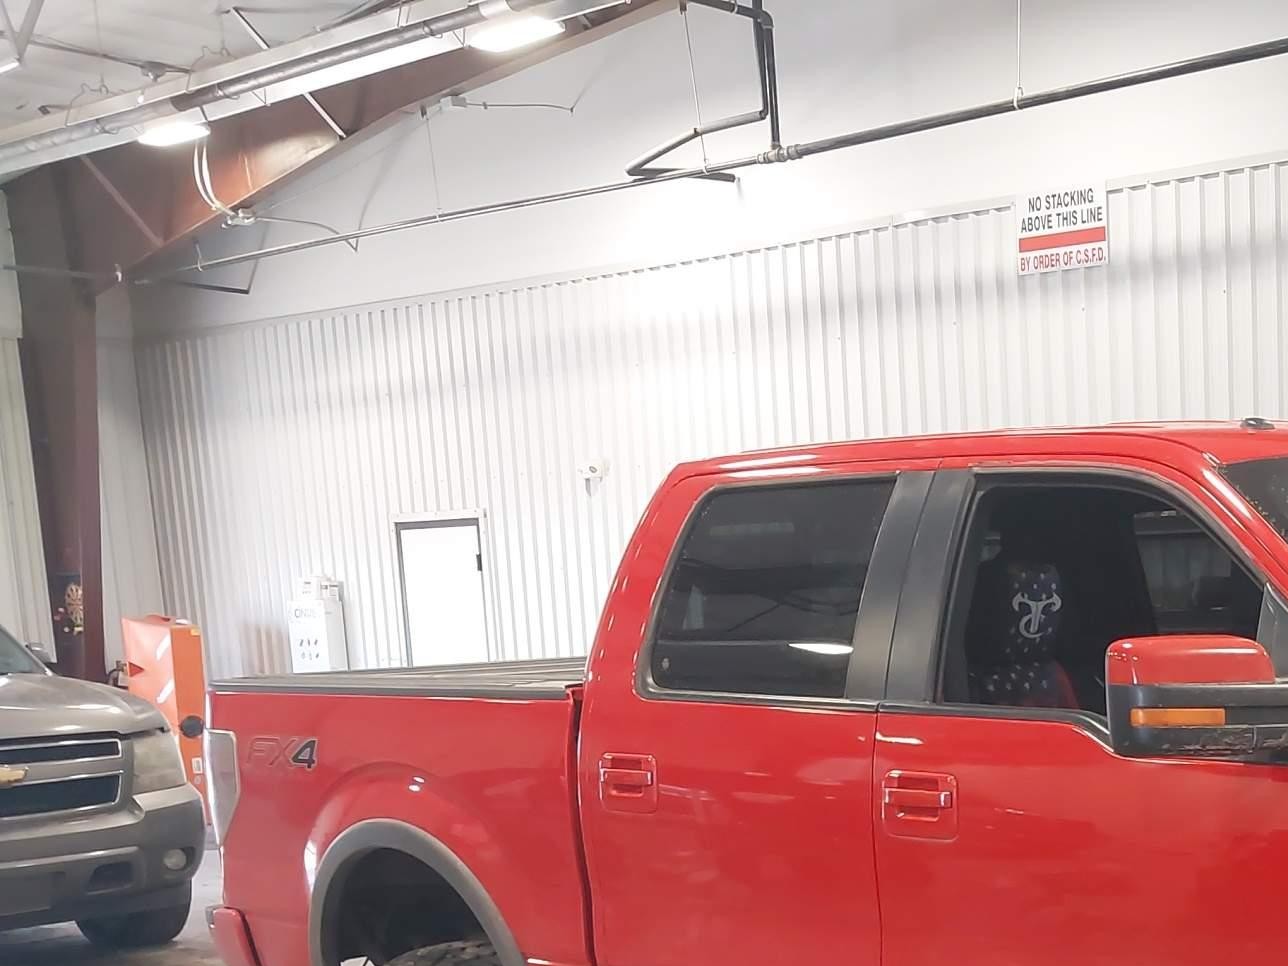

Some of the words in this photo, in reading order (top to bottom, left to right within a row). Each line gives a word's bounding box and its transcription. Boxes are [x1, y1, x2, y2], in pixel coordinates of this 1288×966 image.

[1028, 196, 1042, 213] NO
[1045, 188, 1094, 210] STACKING
[1020, 214, 1053, 234] ABOVE
[1056, 209, 1078, 228] THIS
[1081, 206, 1103, 224] LINE
[1020, 256, 1031, 272] BY
[1033, 252, 1060, 270] ORDER
[1062, 251, 1073, 266] OF
[1075, 247, 1106, 265] C.S.F.D.
[245, 736, 319, 771] FX4
